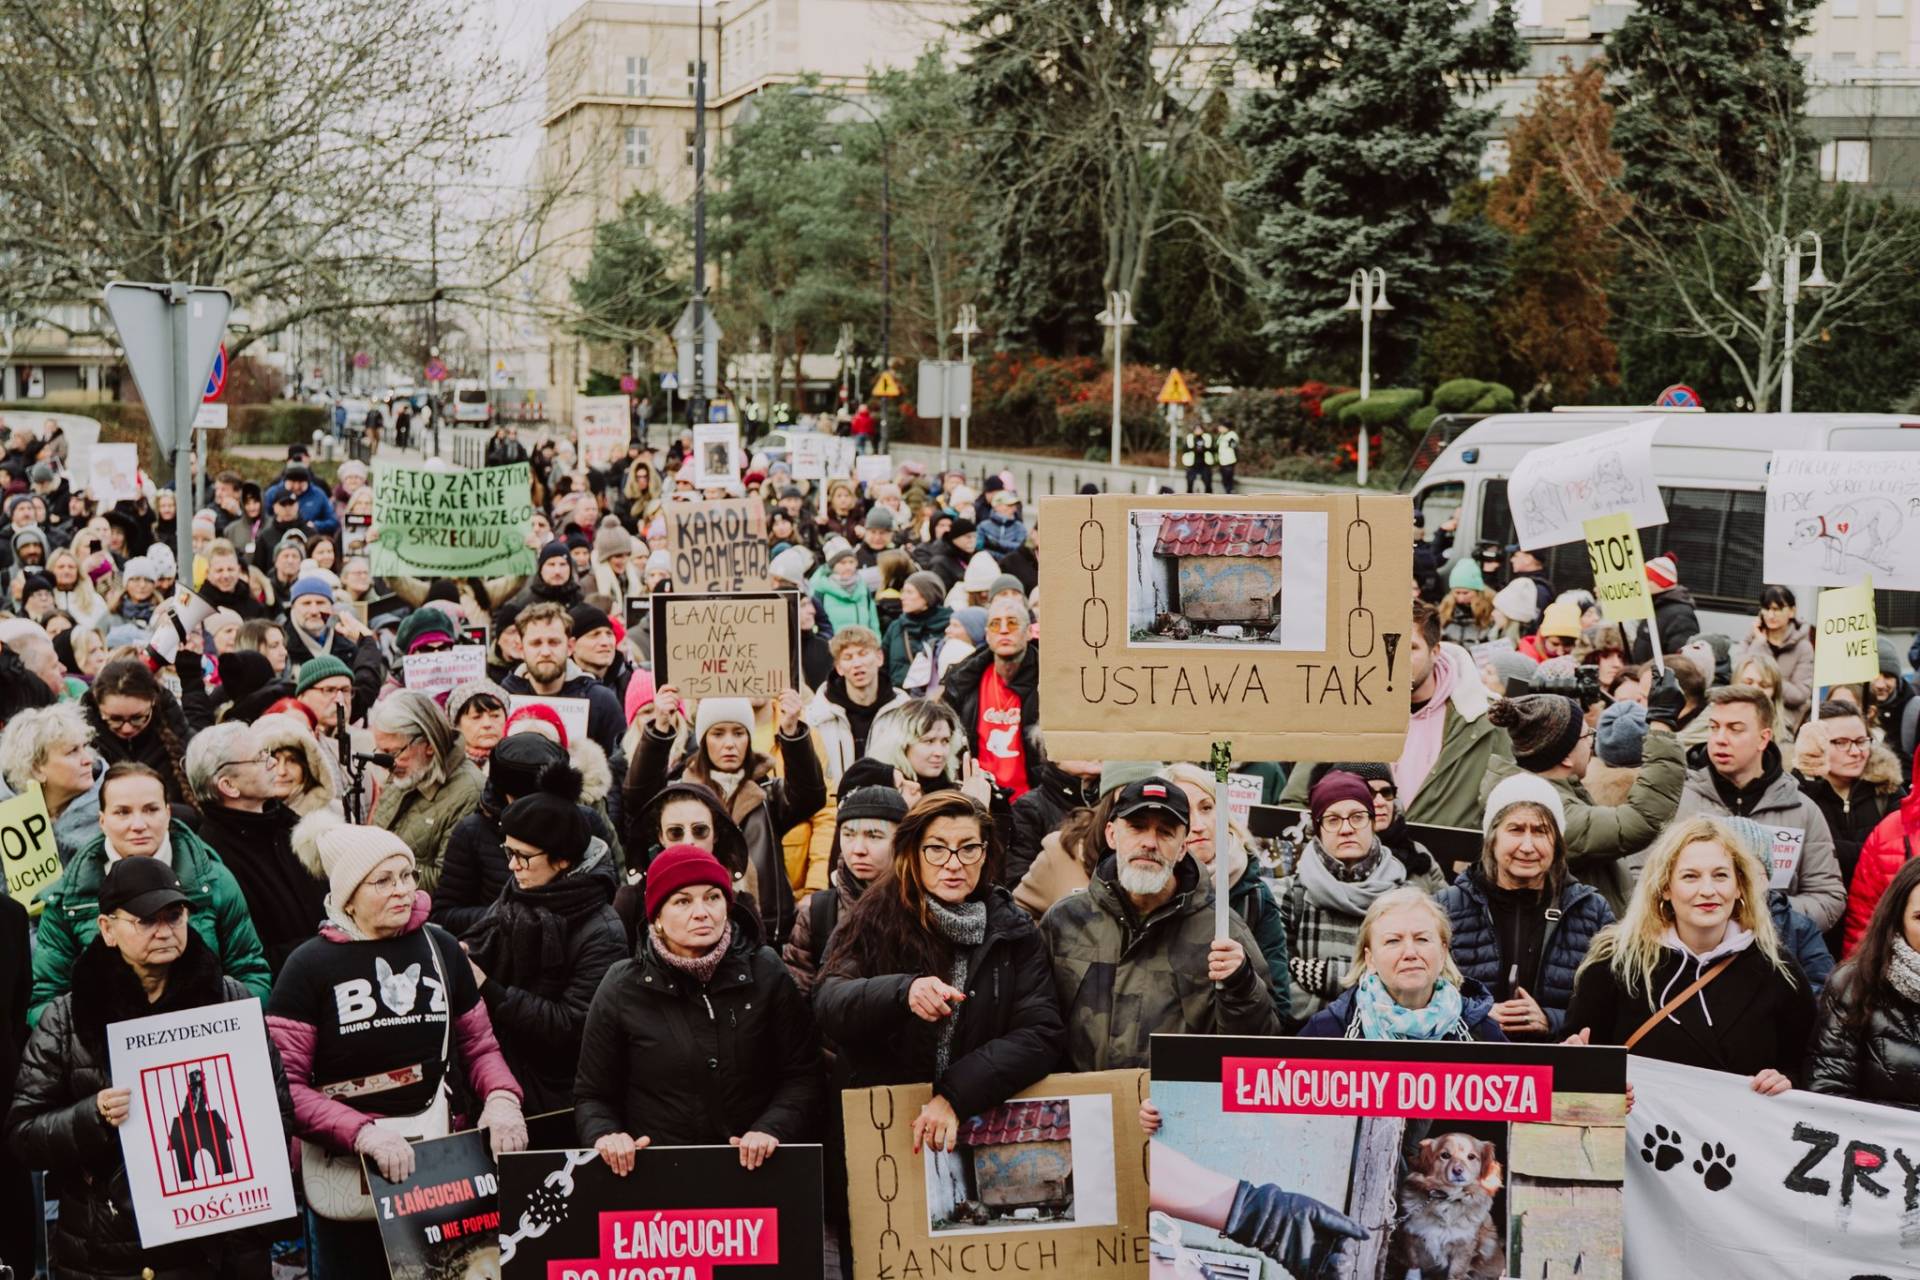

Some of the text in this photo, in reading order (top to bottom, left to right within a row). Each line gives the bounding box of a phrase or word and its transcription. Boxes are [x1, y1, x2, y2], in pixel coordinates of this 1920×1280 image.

[382, 466, 528, 492] WETO ZATRZYMA
[439, 492, 468, 509] ALE
[477, 489, 505, 507] NIE
[375, 503, 532, 527] ZATRZYMA NASZEGO
[408, 527, 501, 549] SPRZECIWU
[676, 539, 769, 585] OPAMIĘTAJ
[670, 602, 775, 626] ŁAŃCUCH
[707, 625, 737, 643] NA
[701, 659, 757, 675] NIE NA
[1080, 663, 1269, 706] USTAWA
[1296, 633, 1402, 706] TAK!
[125, 1017, 241, 1051] PREZYDENCIE
[340, 1021, 371, 1035] BIURO
[373, 1014, 422, 1028] OCHRONY
[1236, 1060, 1539, 1114] ŁAŃCUCHY DO KOSZA
[172, 1193, 235, 1226] DOŚĆ
[380, 1196, 395, 1220] Z
[394, 1178, 475, 1217] ŁAŃCUCHA
[474, 1173, 498, 1198] DO
[424, 1225, 442, 1244] TO
[441, 1221, 462, 1240] NIE
[613, 1211, 764, 1260] ŁAŃCUCHY
[877, 1240, 1057, 1280] ŁAŃCUCH
